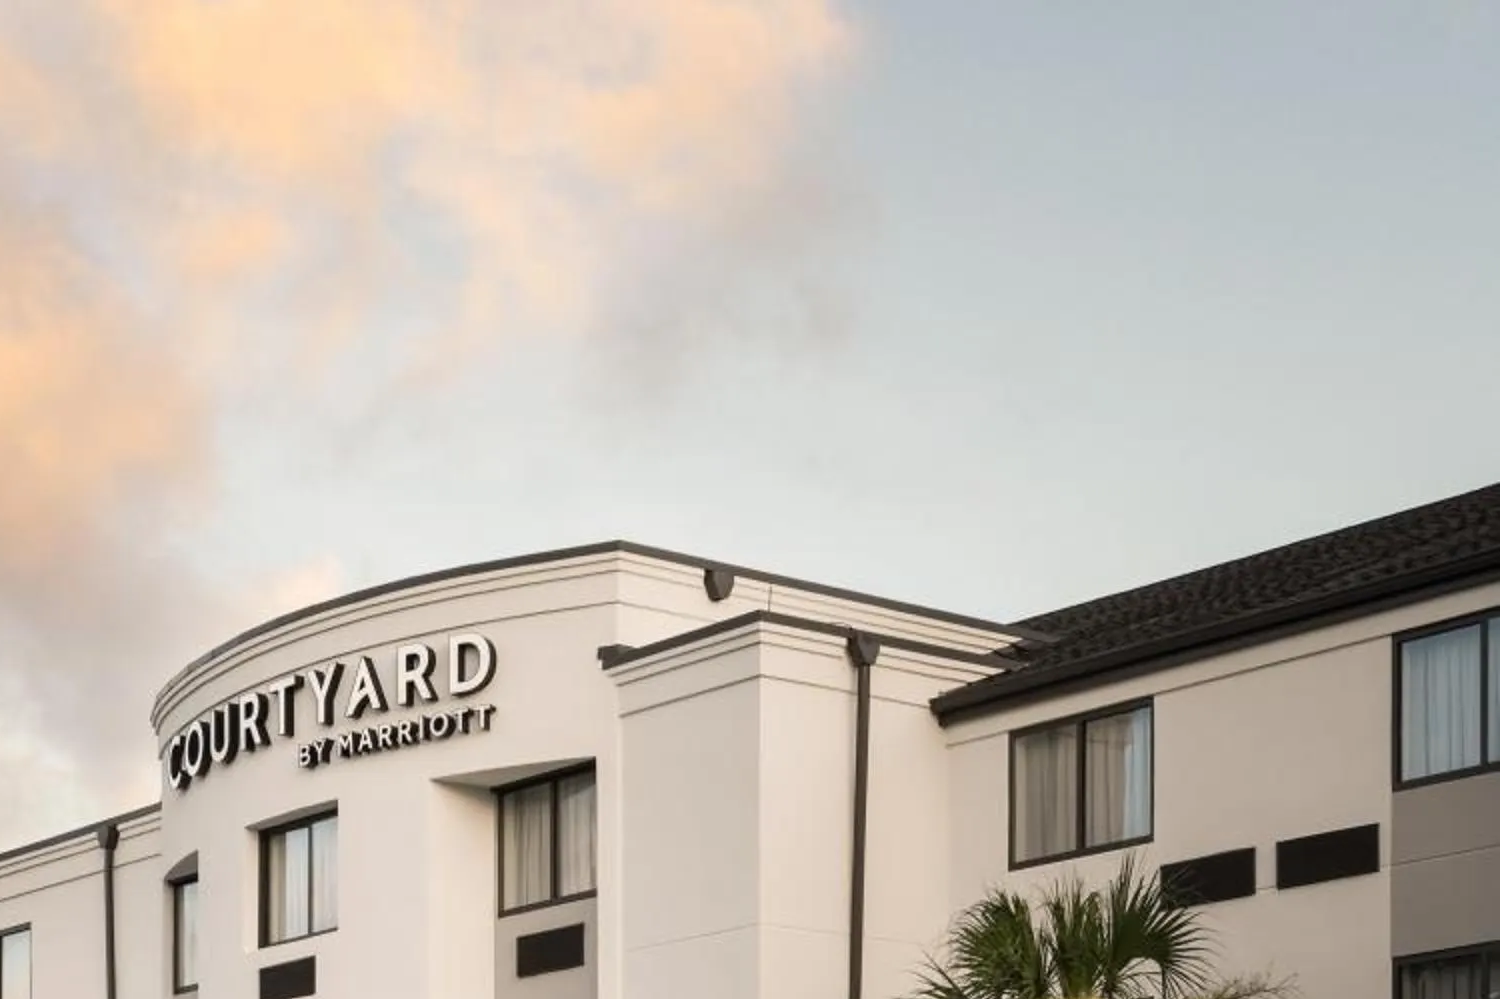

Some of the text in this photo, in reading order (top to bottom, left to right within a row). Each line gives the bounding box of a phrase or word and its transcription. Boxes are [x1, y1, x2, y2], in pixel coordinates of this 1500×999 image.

[168, 632, 496, 791] COURTYARD
[299, 703, 496, 768] BY MARRIOTT
